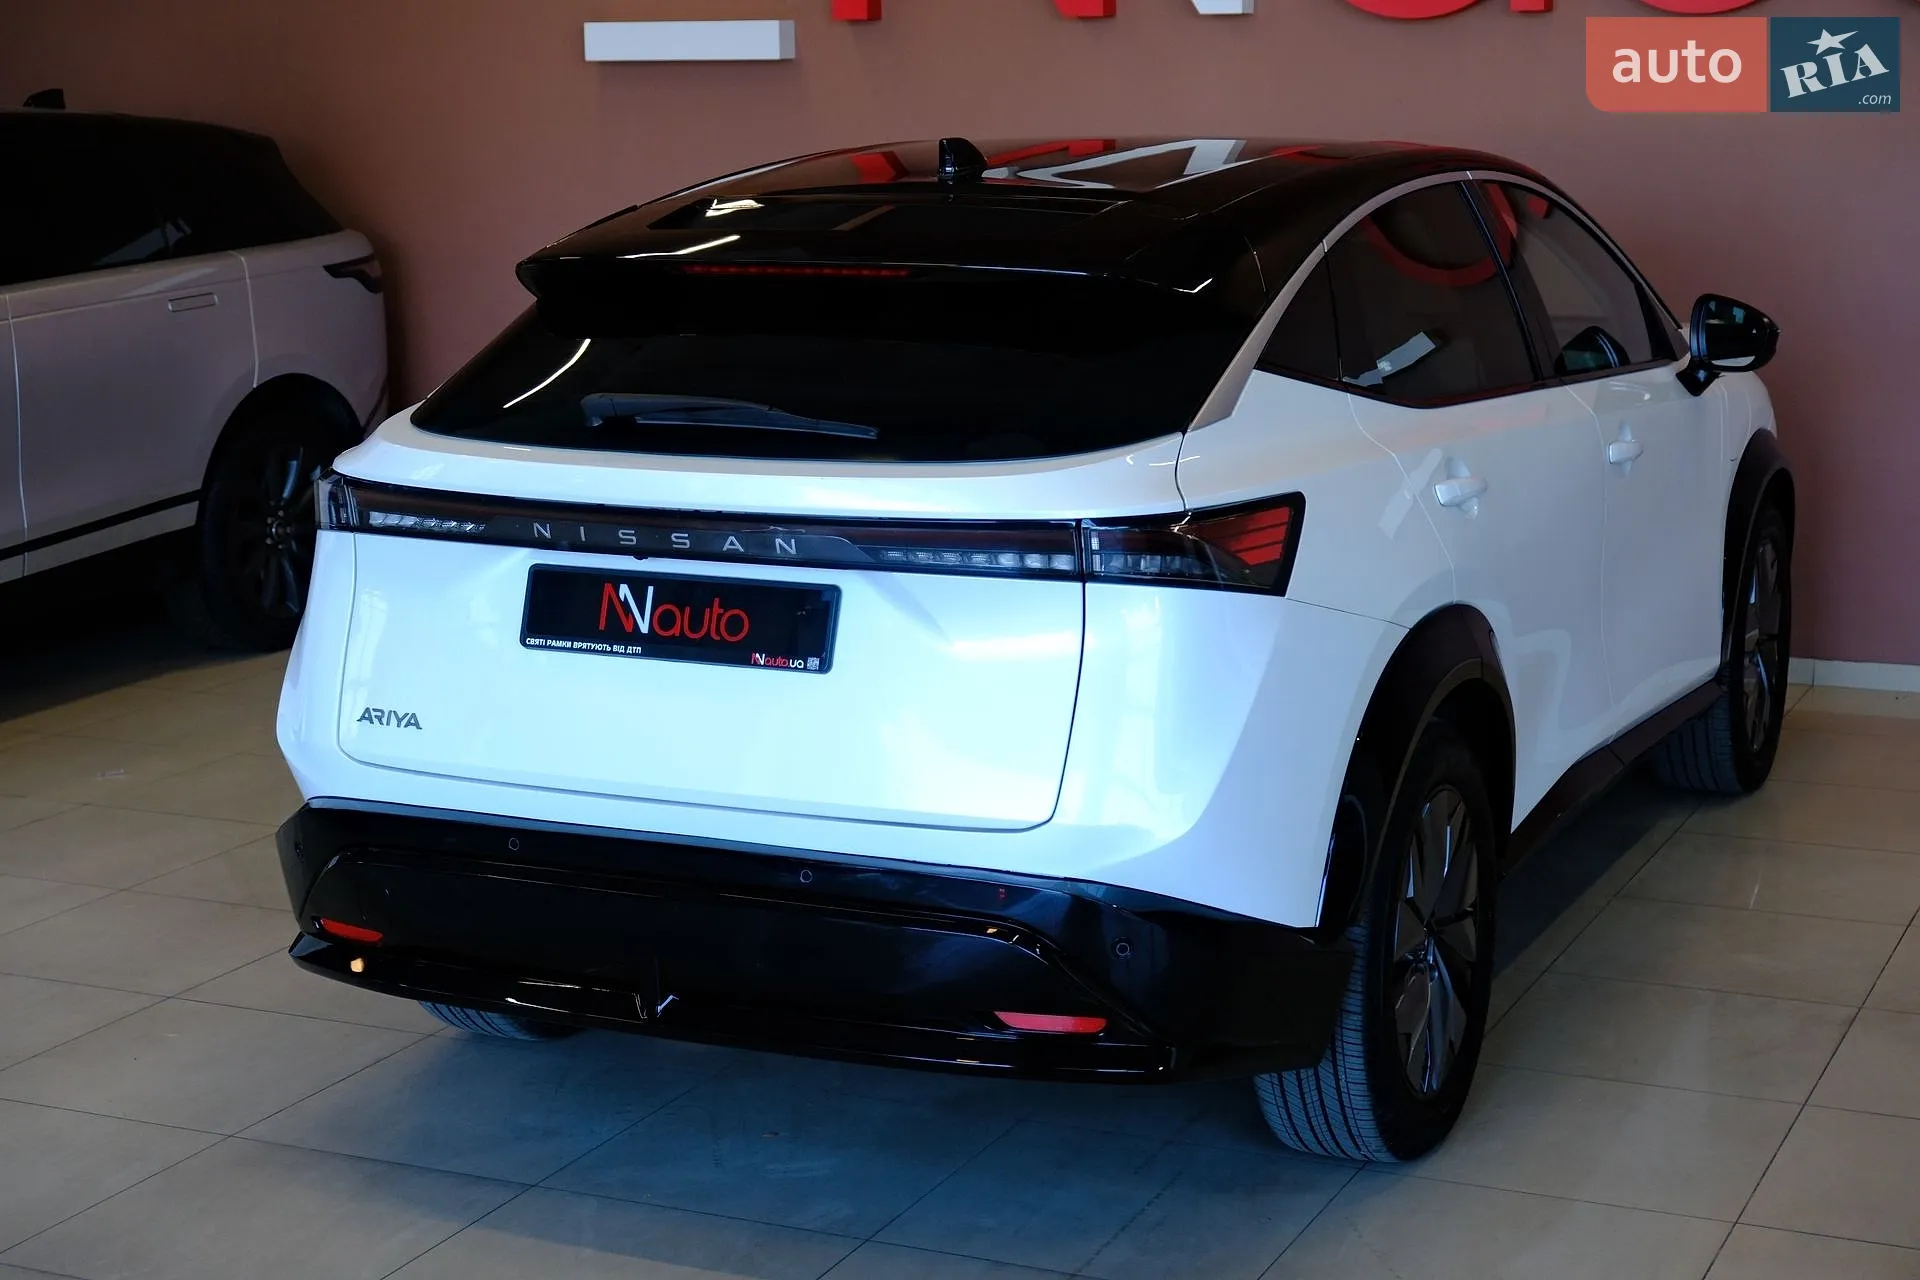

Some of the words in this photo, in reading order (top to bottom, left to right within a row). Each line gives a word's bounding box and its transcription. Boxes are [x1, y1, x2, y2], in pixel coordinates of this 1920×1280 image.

[533, 521, 797, 555] NISSAN
[525, 637, 545, 646] СВЯТІ
[547, 639, 571, 648] РАМКИ
[573, 641, 611, 652] ВРЯТУЮТЬ
[613, 644, 625, 653] ВІД
[626, 645, 642, 654] ДТП
[356, 706, 422, 730] ARIYA
